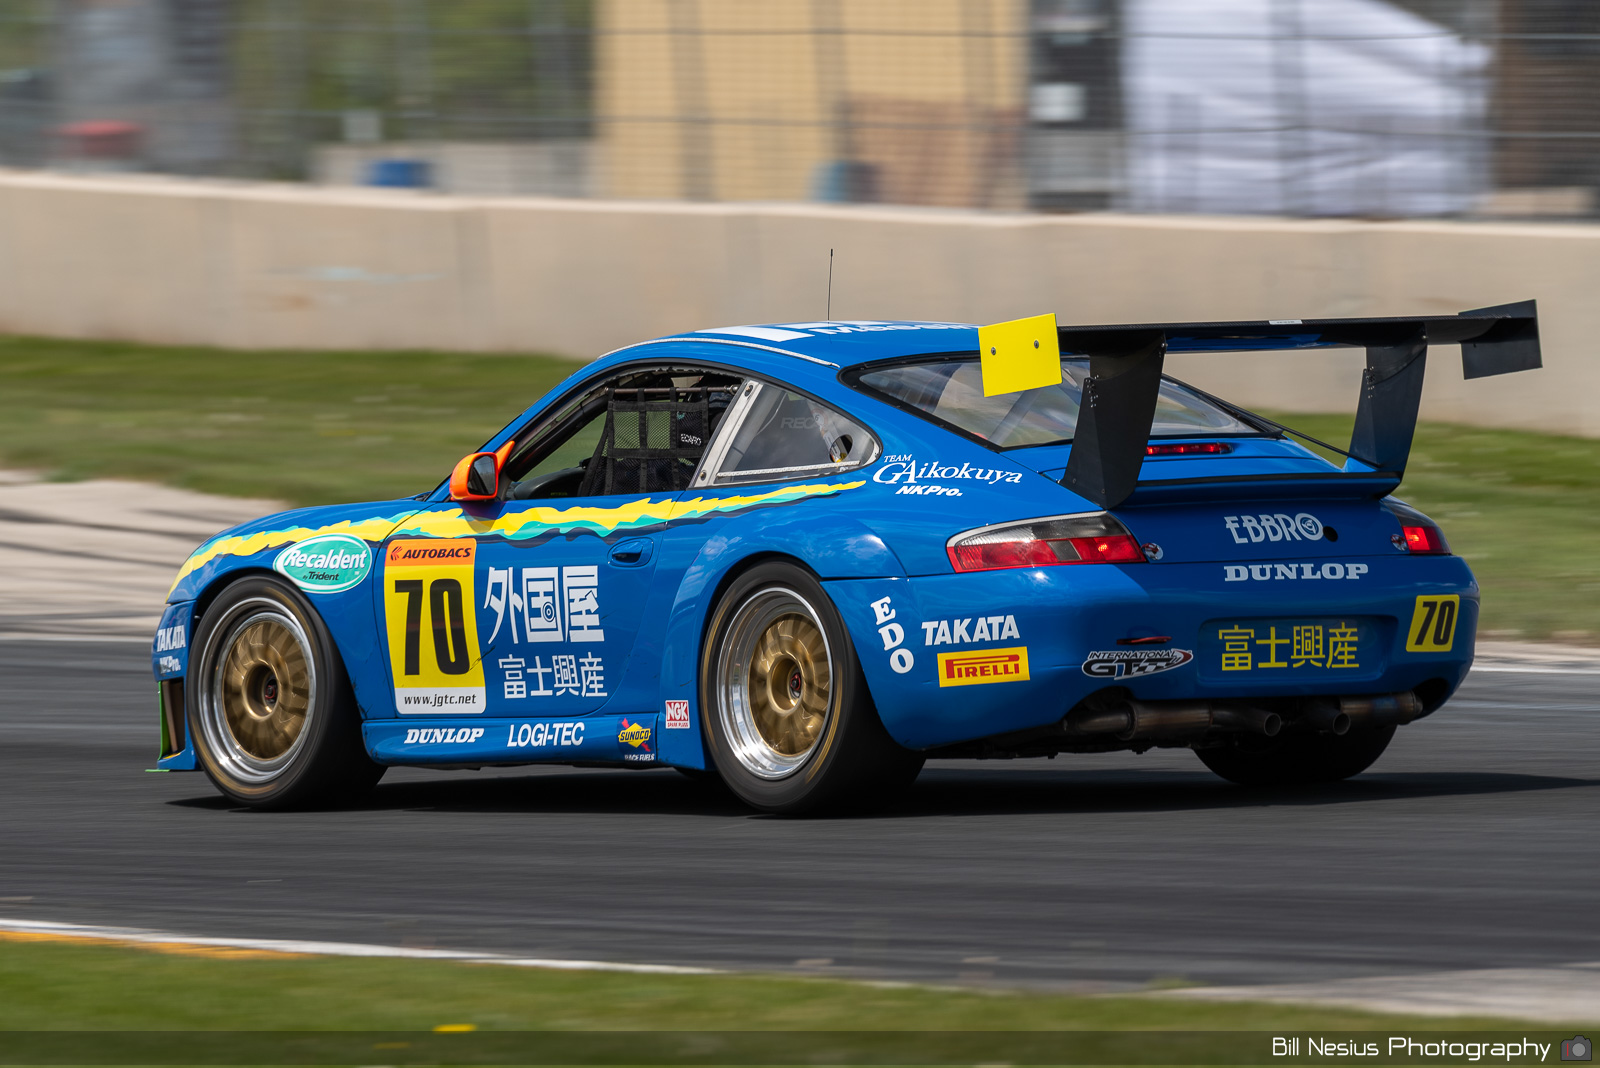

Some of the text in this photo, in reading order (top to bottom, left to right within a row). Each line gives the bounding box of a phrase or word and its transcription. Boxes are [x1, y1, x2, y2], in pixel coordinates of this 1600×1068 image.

[884, 454, 912, 463] TEAM
[873, 460, 1022, 485] GAikokuya
[1224, 513, 1324, 544] EBBRO
[284, 549, 367, 569] Recaldent
[402, 547, 472, 560] AUTOBACS
[309, 571, 339, 580] Trident
[1224, 563, 1369, 582] DUNLOP
[484, 565, 605, 645] 外国屋
[395, 578, 470, 676] 70
[871, 596, 914, 674] EDO
[921, 614, 1020, 646] TAKATA
[1414, 601, 1456, 646] 70
[157, 625, 186, 652] TAKATA
[1218, 622, 1360, 671] 富士興産
[946, 654, 1020, 679] PIRELLI
[1089, 651, 1175, 659] INTERNATIONAL
[498, 652, 608, 699] 富士興産
[404, 694, 477, 707] www.jgtc.net
[667, 703, 688, 720] NGK
[404, 728, 484, 744] DUNLOP
[507, 722, 585, 747] LOGI-TEC
[620, 730, 650, 741] SUNOCO
